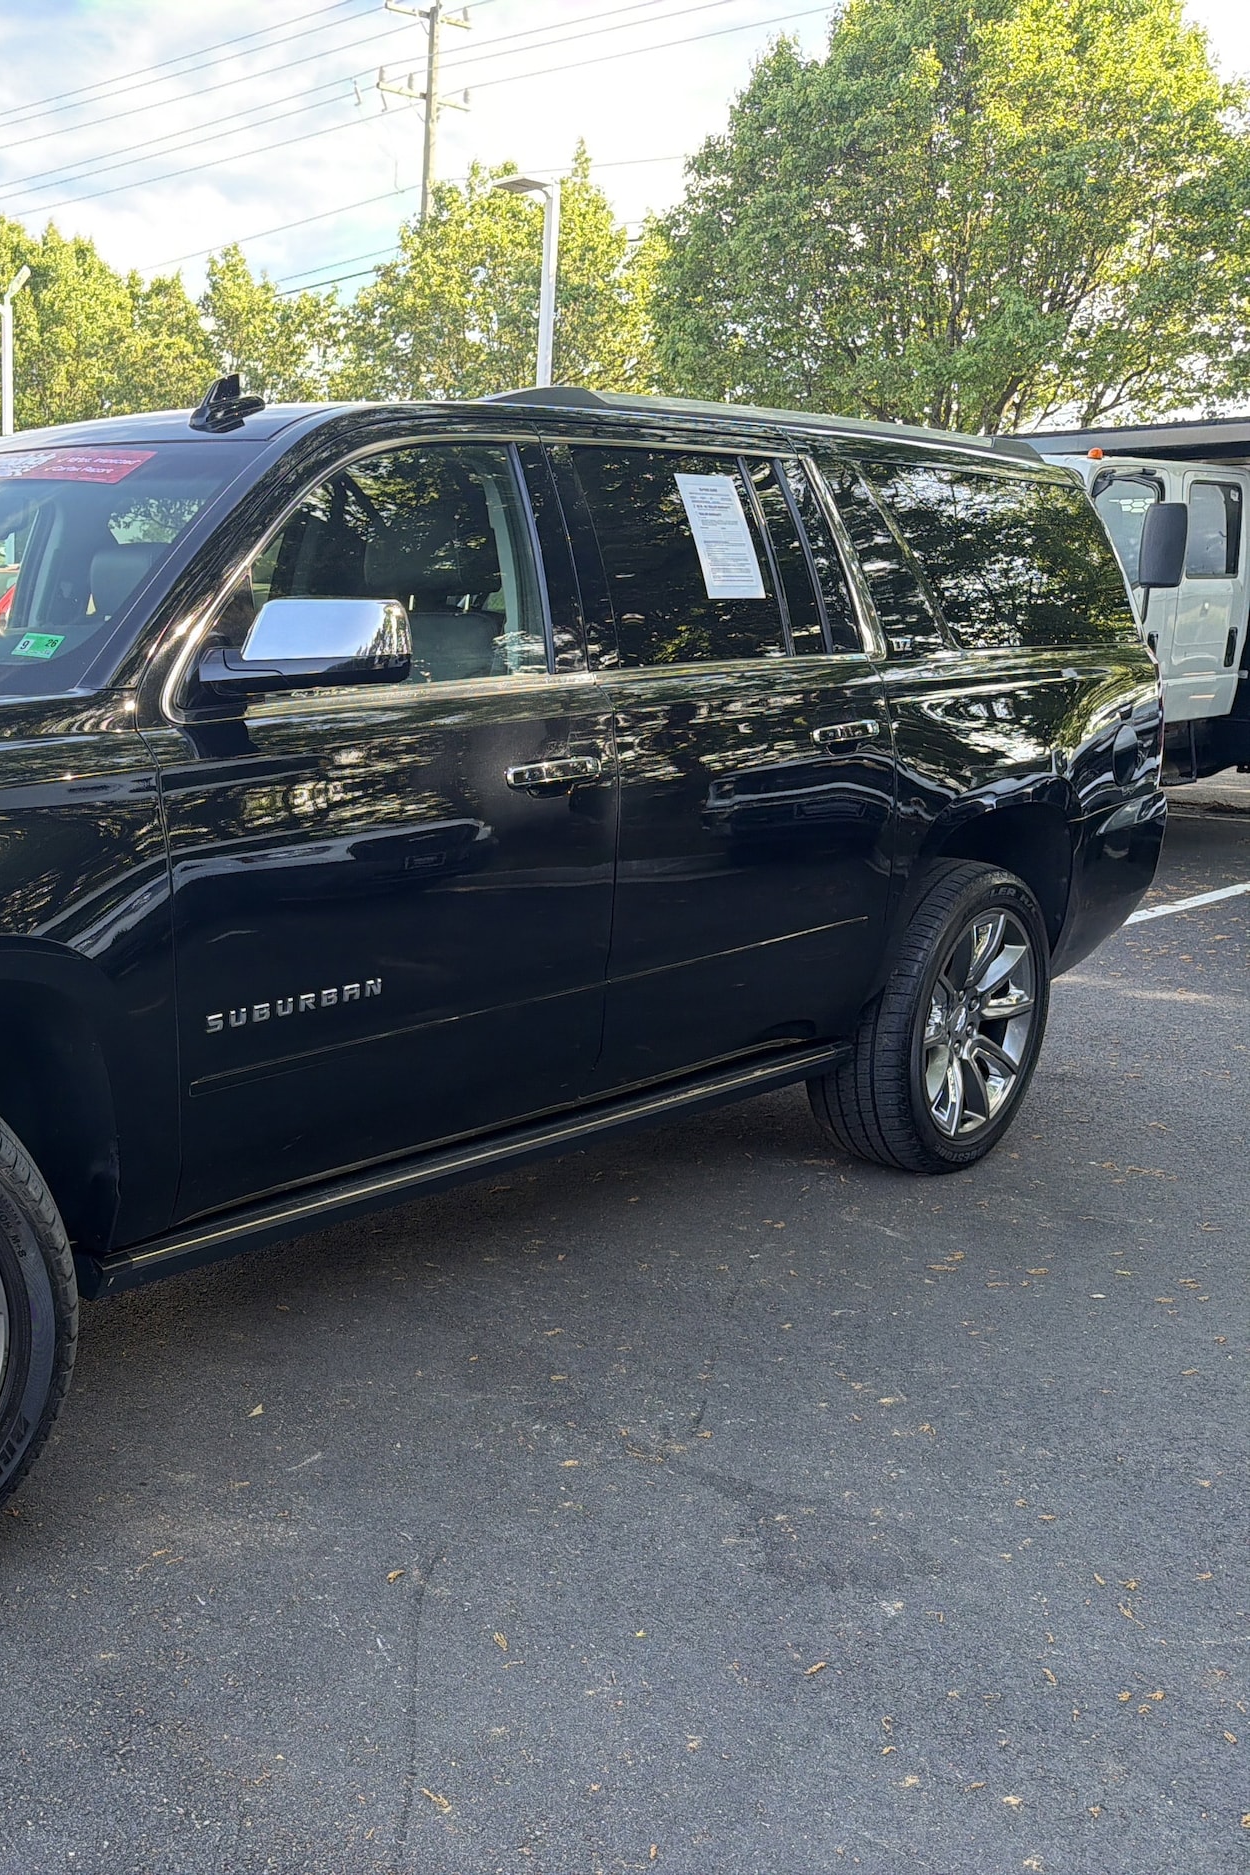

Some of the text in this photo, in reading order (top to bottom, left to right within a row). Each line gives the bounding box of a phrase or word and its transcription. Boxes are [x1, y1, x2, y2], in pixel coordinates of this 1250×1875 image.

[20, 638, 59, 650] 9 26
[206, 977, 382, 1033] SUBURBAN
